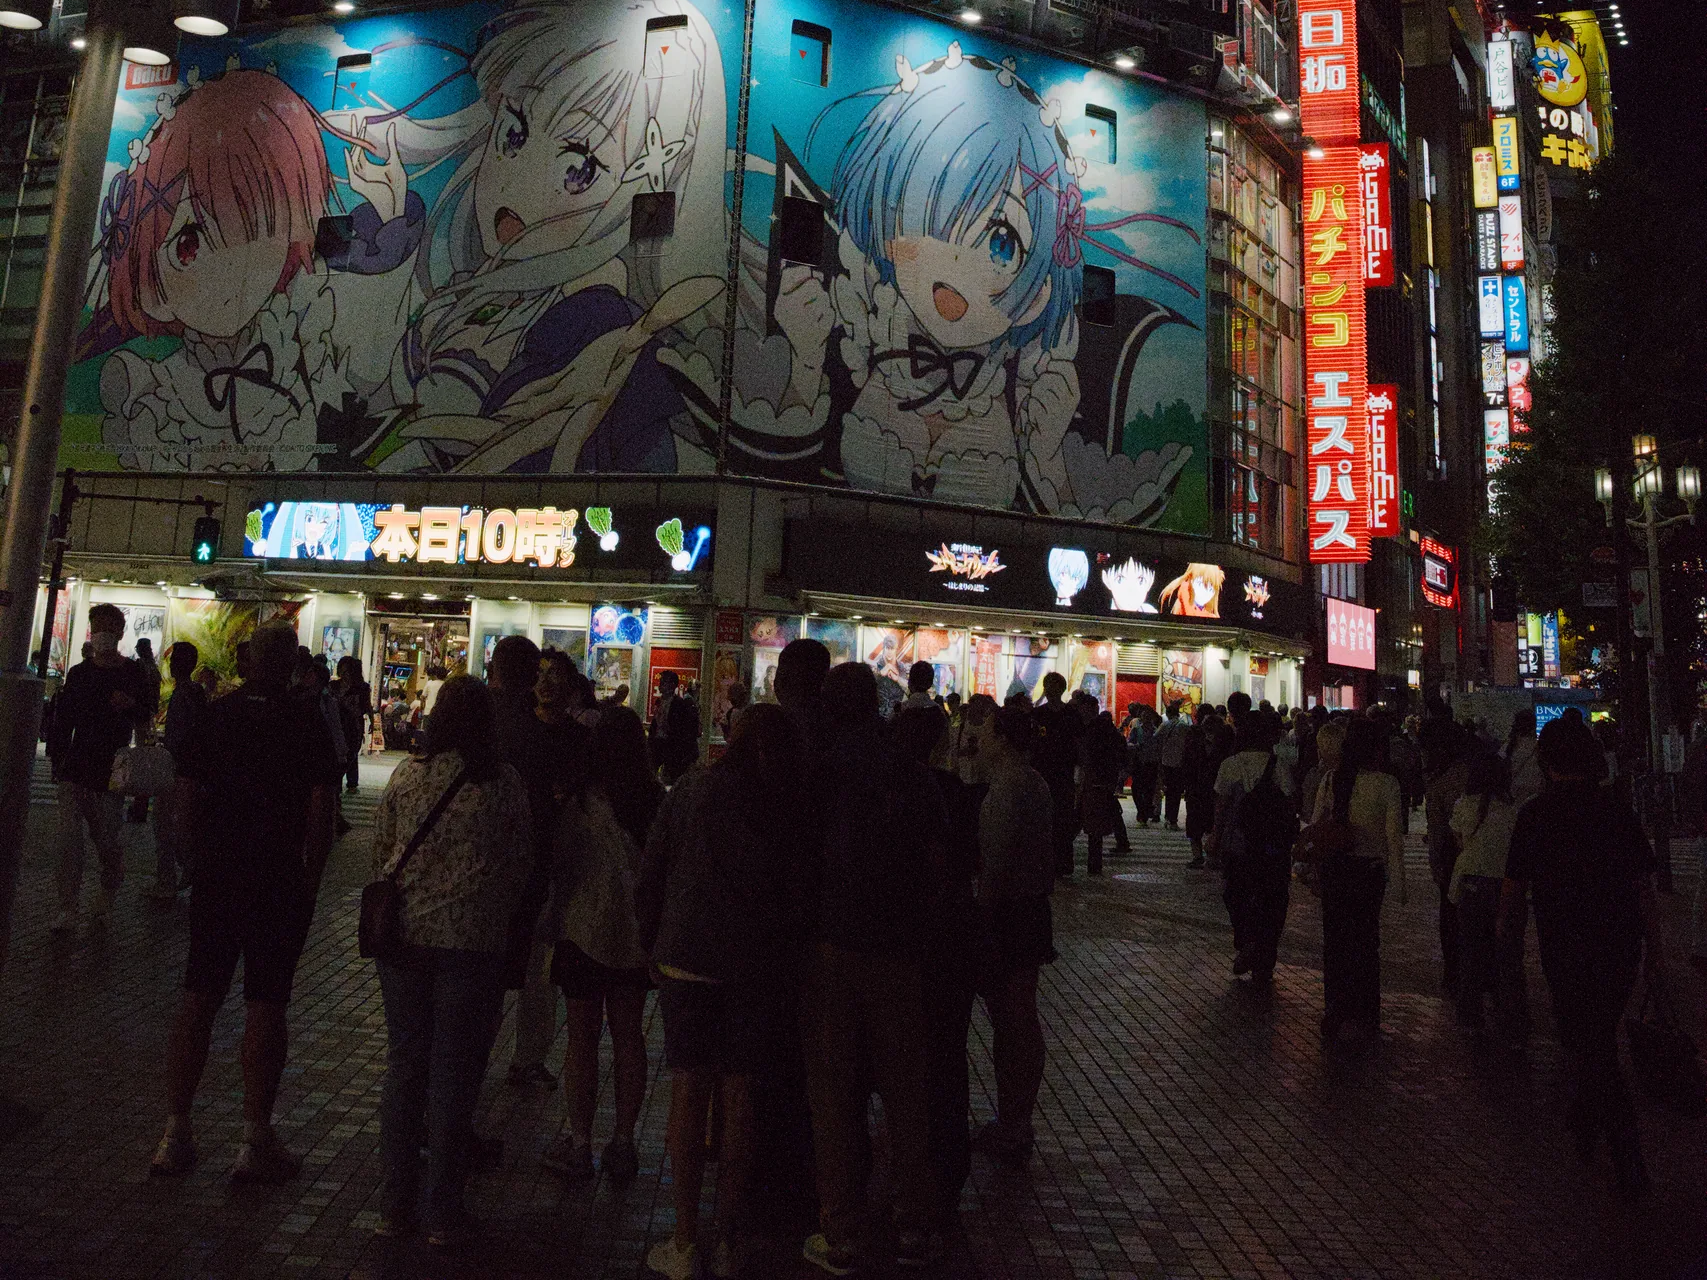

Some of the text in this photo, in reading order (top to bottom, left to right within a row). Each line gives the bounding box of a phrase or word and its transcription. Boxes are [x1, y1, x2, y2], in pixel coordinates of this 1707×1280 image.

[1499, 122, 1513, 171] プロミス
[1501, 177, 1516, 187] 6F
[1364, 171, 1388, 279] GAME
[1485, 213, 1497, 270] BUZZ STAND
[1479, 241, 1487, 270] KARAOKE
[1508, 285, 1521, 343] セントラル
[1308, 183, 1357, 551] パチンコ エスパス
[1486, 393, 1504, 405] 7F
[1371, 415, 1395, 528] GAME
[370, 504, 564, 568] 本日10時
[560, 508, 578, 568] オープン
